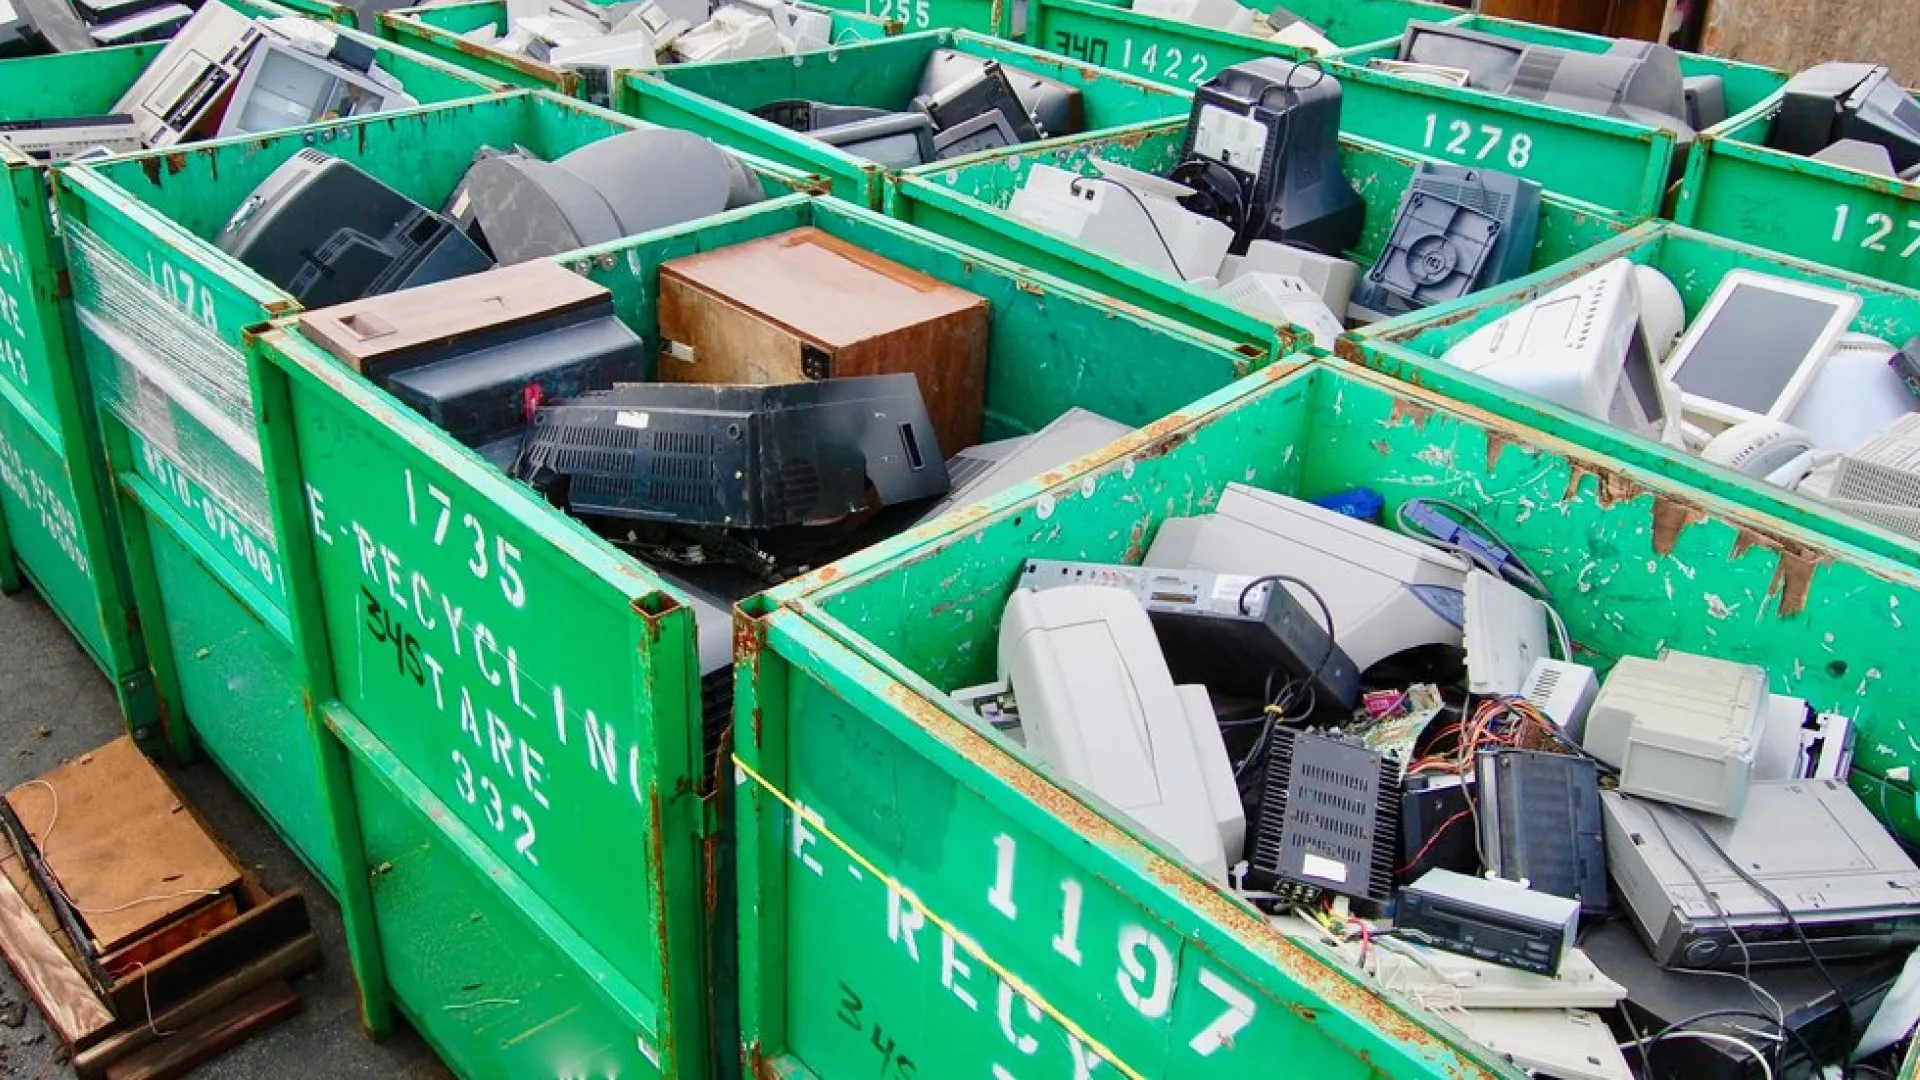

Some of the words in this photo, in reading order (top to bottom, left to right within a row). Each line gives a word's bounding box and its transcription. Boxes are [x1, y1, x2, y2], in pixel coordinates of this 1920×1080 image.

[1122, 37, 1208, 87] 1422
[1423, 112, 1533, 169] 1278
[146, 251, 218, 336] 1078
[404, 468, 526, 609] 1735
[423, 652, 549, 809] TARE
[451, 749, 539, 867] 332
[988, 832, 1256, 1057] 1197
